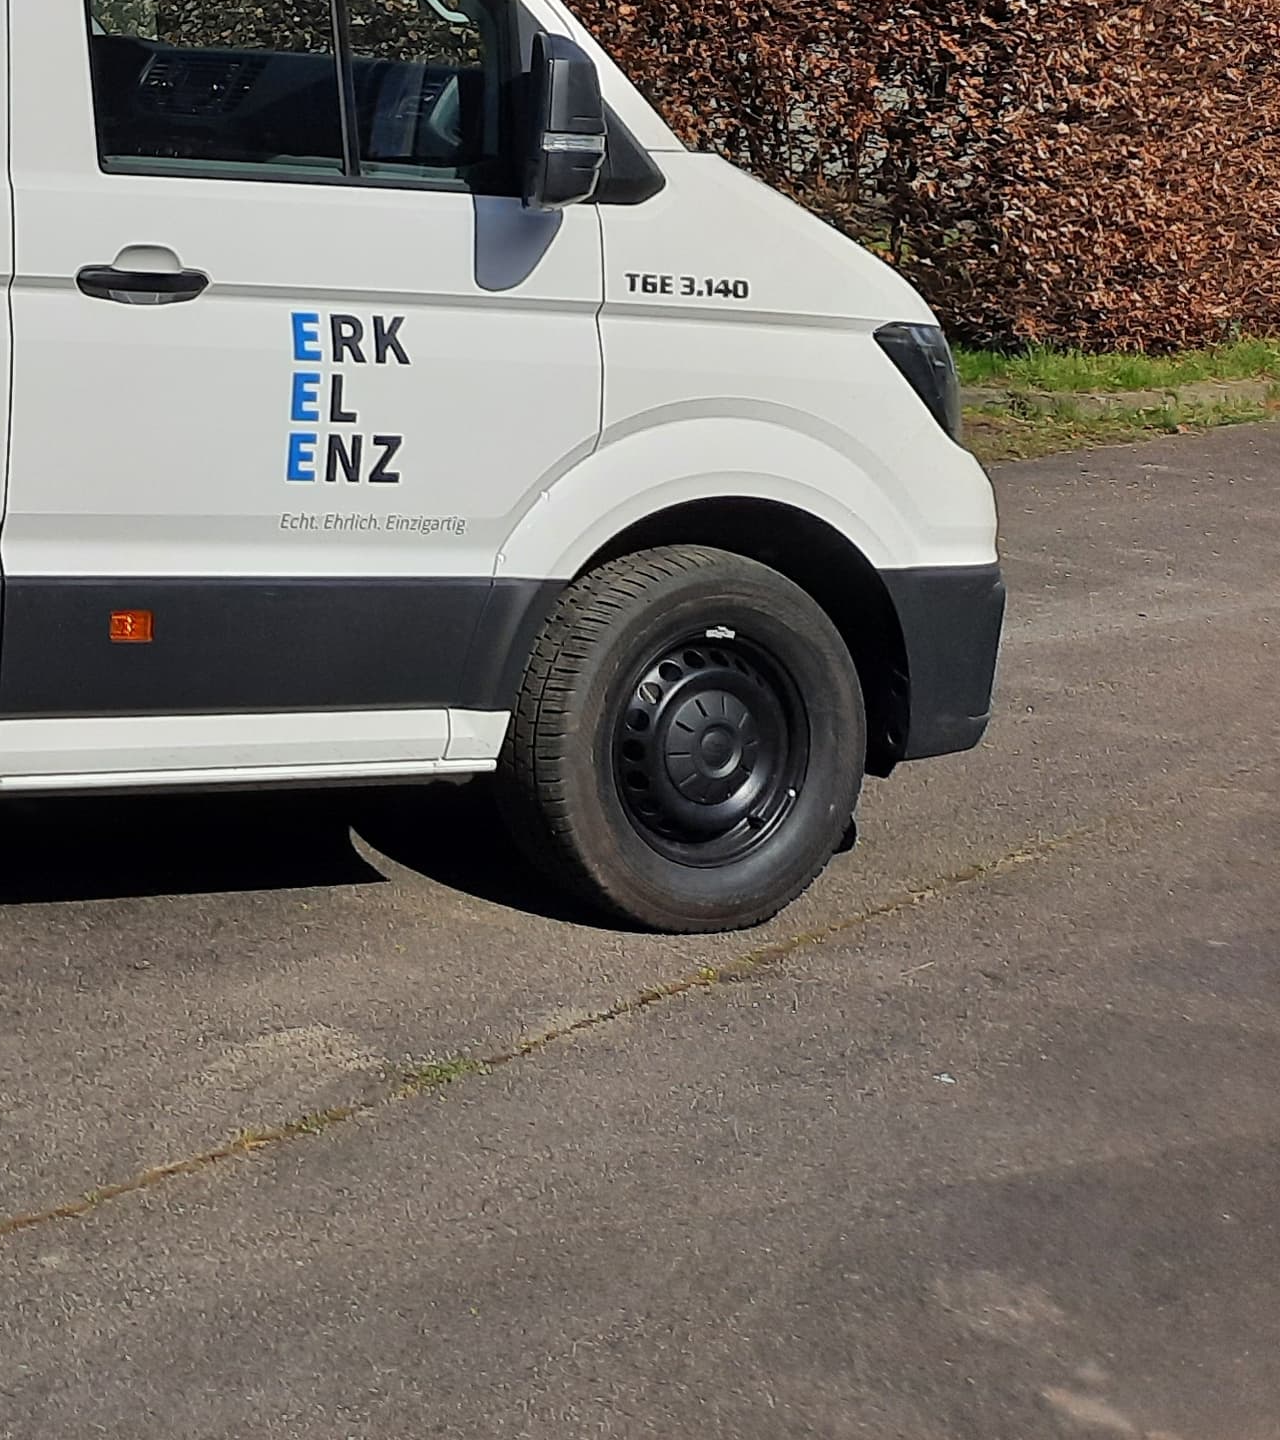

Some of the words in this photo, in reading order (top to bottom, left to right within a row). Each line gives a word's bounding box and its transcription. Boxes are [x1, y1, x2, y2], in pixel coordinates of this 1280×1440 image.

[624, 273, 673, 295] TGE
[680, 276, 749, 299] 3.140
[291, 312, 411, 365] ERK
[291, 372, 357, 423] EL
[287, 433, 402, 483] ENZ
[280, 513, 318, 530] Echt.
[324, 514, 381, 531] Ehrlich.
[386, 515, 466, 536] Einzigartig
